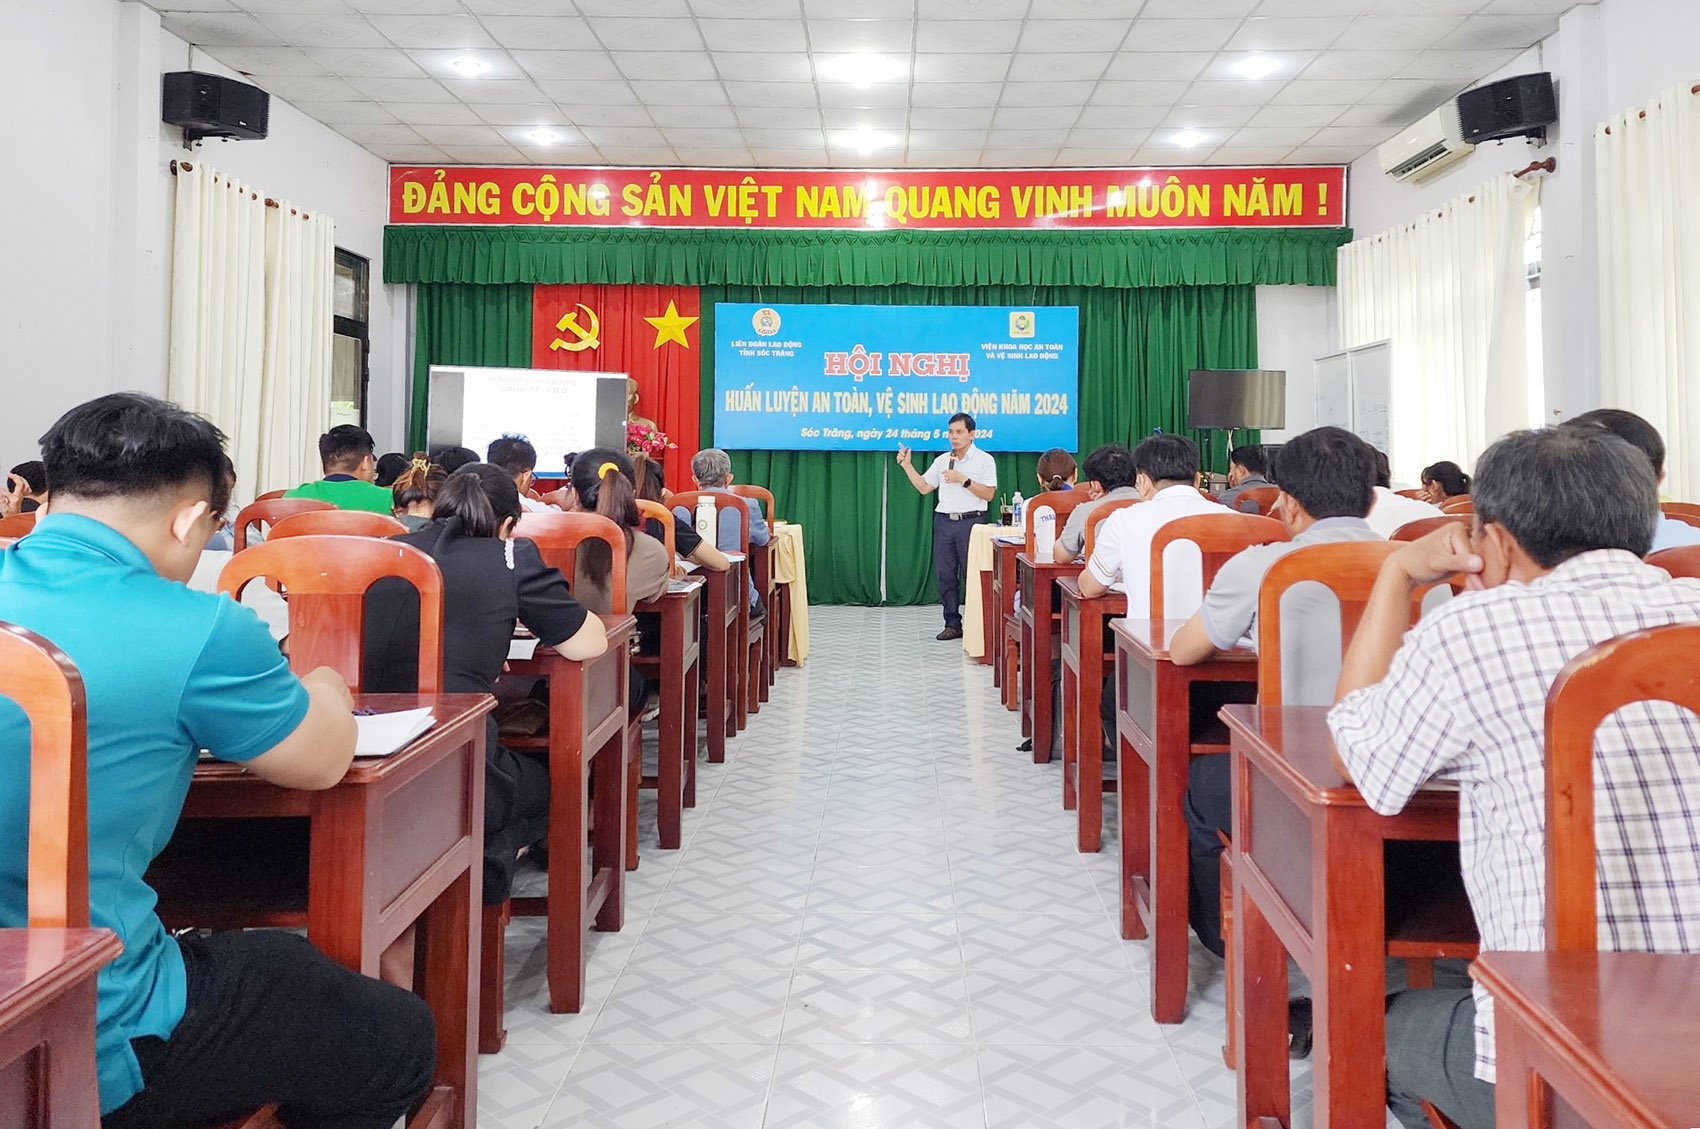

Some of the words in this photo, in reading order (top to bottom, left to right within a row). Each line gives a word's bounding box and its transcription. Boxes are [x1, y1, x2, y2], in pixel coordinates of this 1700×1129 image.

[402, 170, 500, 215] ĐẢNG
[512, 174, 610, 221] CỘNG
[621, 171, 692, 217] SẢN
[704, 177, 783, 224] VIỆT
[796, 185, 869, 218] NAM
[884, 185, 1000, 224] QUANG
[1011, 185, 1093, 218] VINH
[1107, 176, 1210, 218] MUÔN
[1223, 177, 1302, 216] NĂM
[783, 340, 802, 349] ĐỘNG
[981, 342, 997, 351] VIỆN
[1018, 343, 1033, 351] HỌC
[1045, 342, 1064, 351] TOÀN
[756, 348, 770, 357] SÓC
[771, 349, 795, 357] TRĂNG
[985, 351, 996, 359] VÀ
[996, 351, 1006, 360] VỆ
[824, 344, 883, 382] HỘI
[888, 352, 971, 382] NGHỊ
[725, 381, 762, 412] HUẤN
[765, 385, 809, 417] LUYỆN
[812, 391, 831, 413] AN
[834, 386, 873, 418] TOÀN,
[876, 386, 894, 419] VỆ
[897, 392, 928, 414] SINH
[932, 392, 959, 414] LAO
[961, 387, 998, 419] ĐỘNG
[1001, 388, 1031, 414] NĂM
[1034, 392, 1069, 415] 2024
[801, 427, 820, 438] Sóc
[823, 427, 854, 440] Trăng,
[856, 428, 884, 440] ngày
[885, 429, 898, 438] 24
[900, 428, 931, 441] tháng
[933, 428, 941, 439] 5
[974, 429, 994, 439] 024
